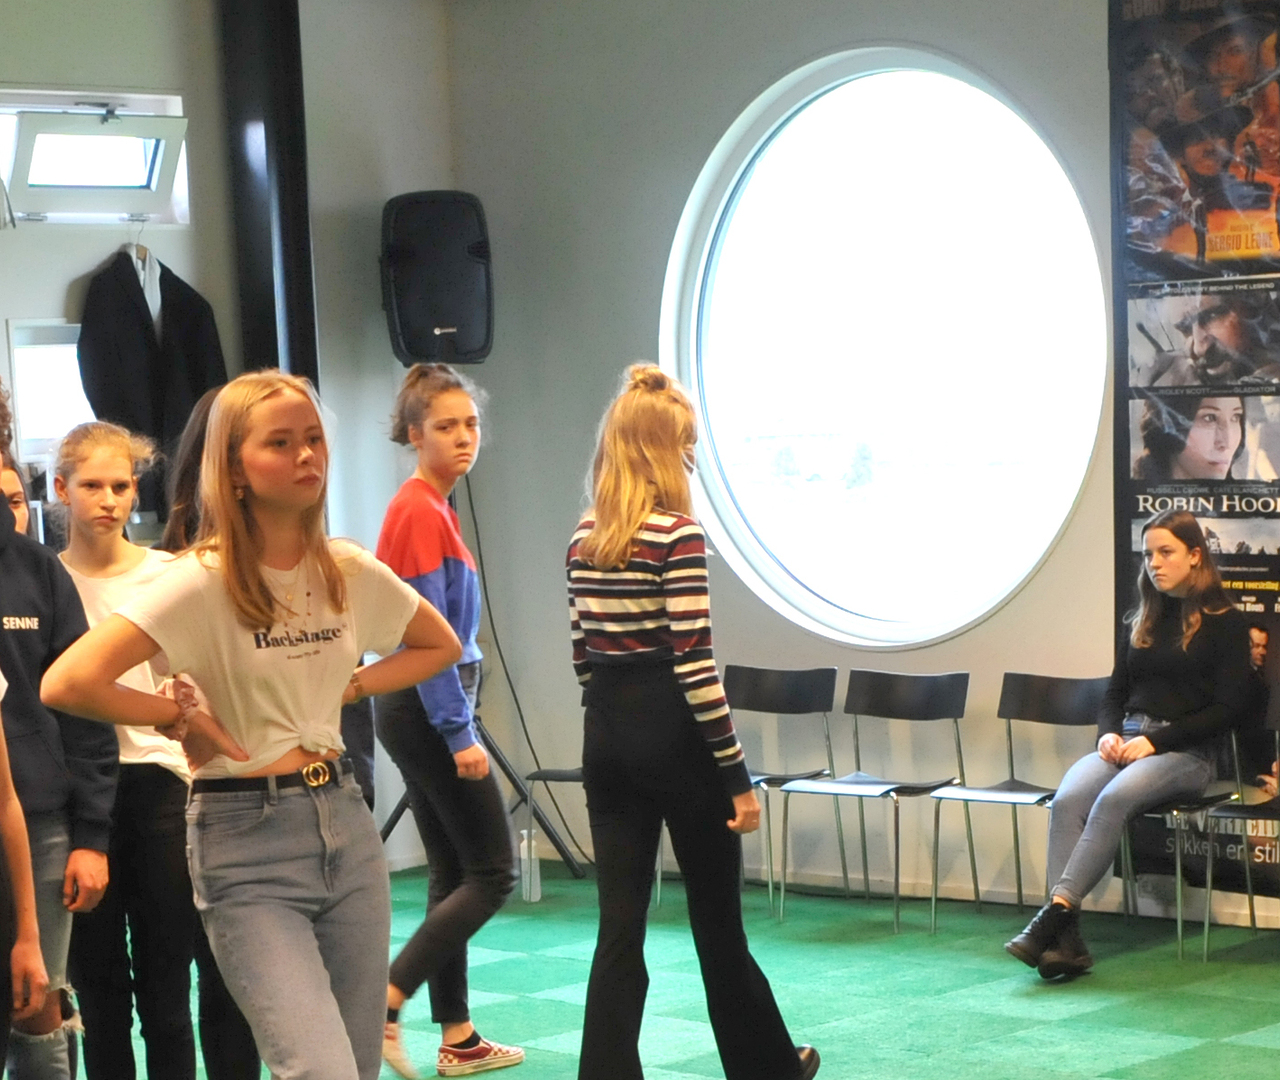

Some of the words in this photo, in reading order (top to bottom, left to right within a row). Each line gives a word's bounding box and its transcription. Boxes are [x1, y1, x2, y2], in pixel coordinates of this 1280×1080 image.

[1208, 234, 1242, 252] SERGIO
[1136, 495, 1215, 514] ROBIN
[2, 616, 39, 630] SENNE
[252, 627, 342, 650] Backstage
